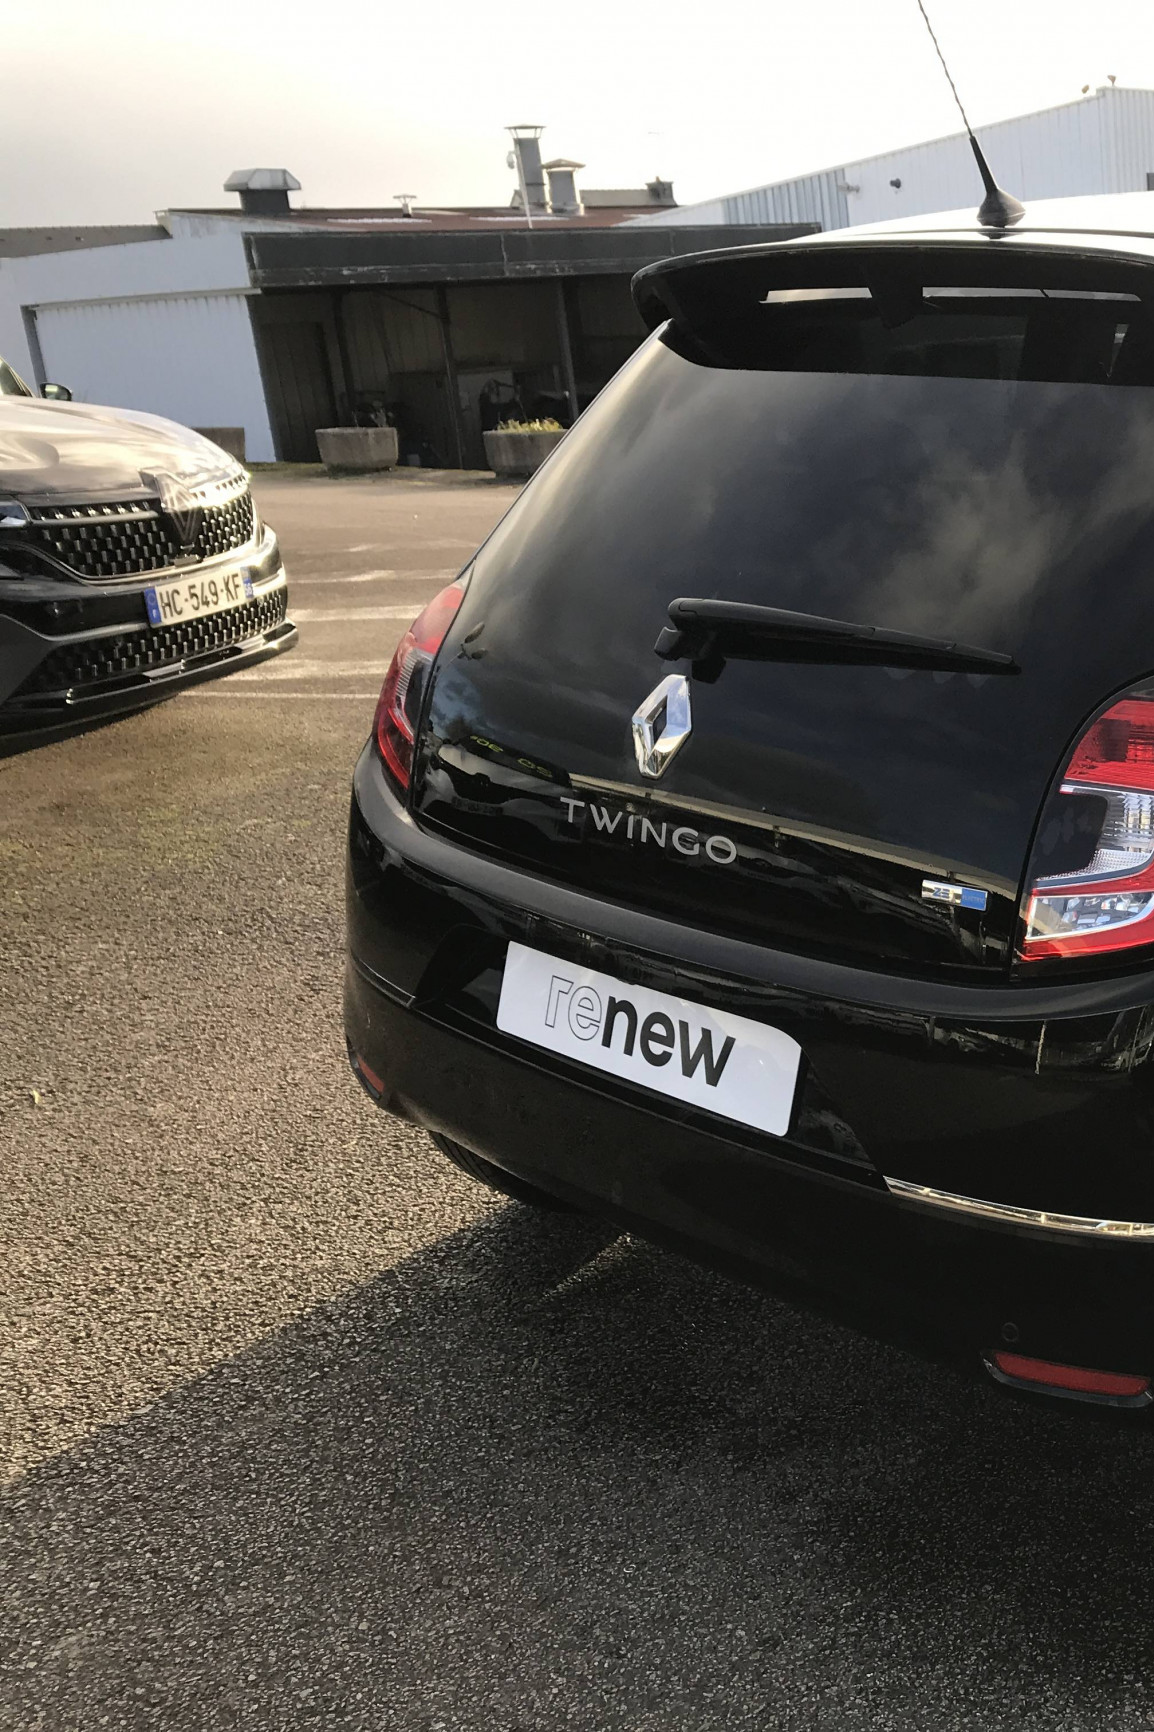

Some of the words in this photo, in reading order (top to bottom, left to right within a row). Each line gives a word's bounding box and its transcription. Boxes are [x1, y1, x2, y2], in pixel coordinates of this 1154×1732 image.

[159, 573, 241, 619] HC-549-KF
[560, 796, 737, 865] TWINGO
[544, 974, 737, 1088] renew
